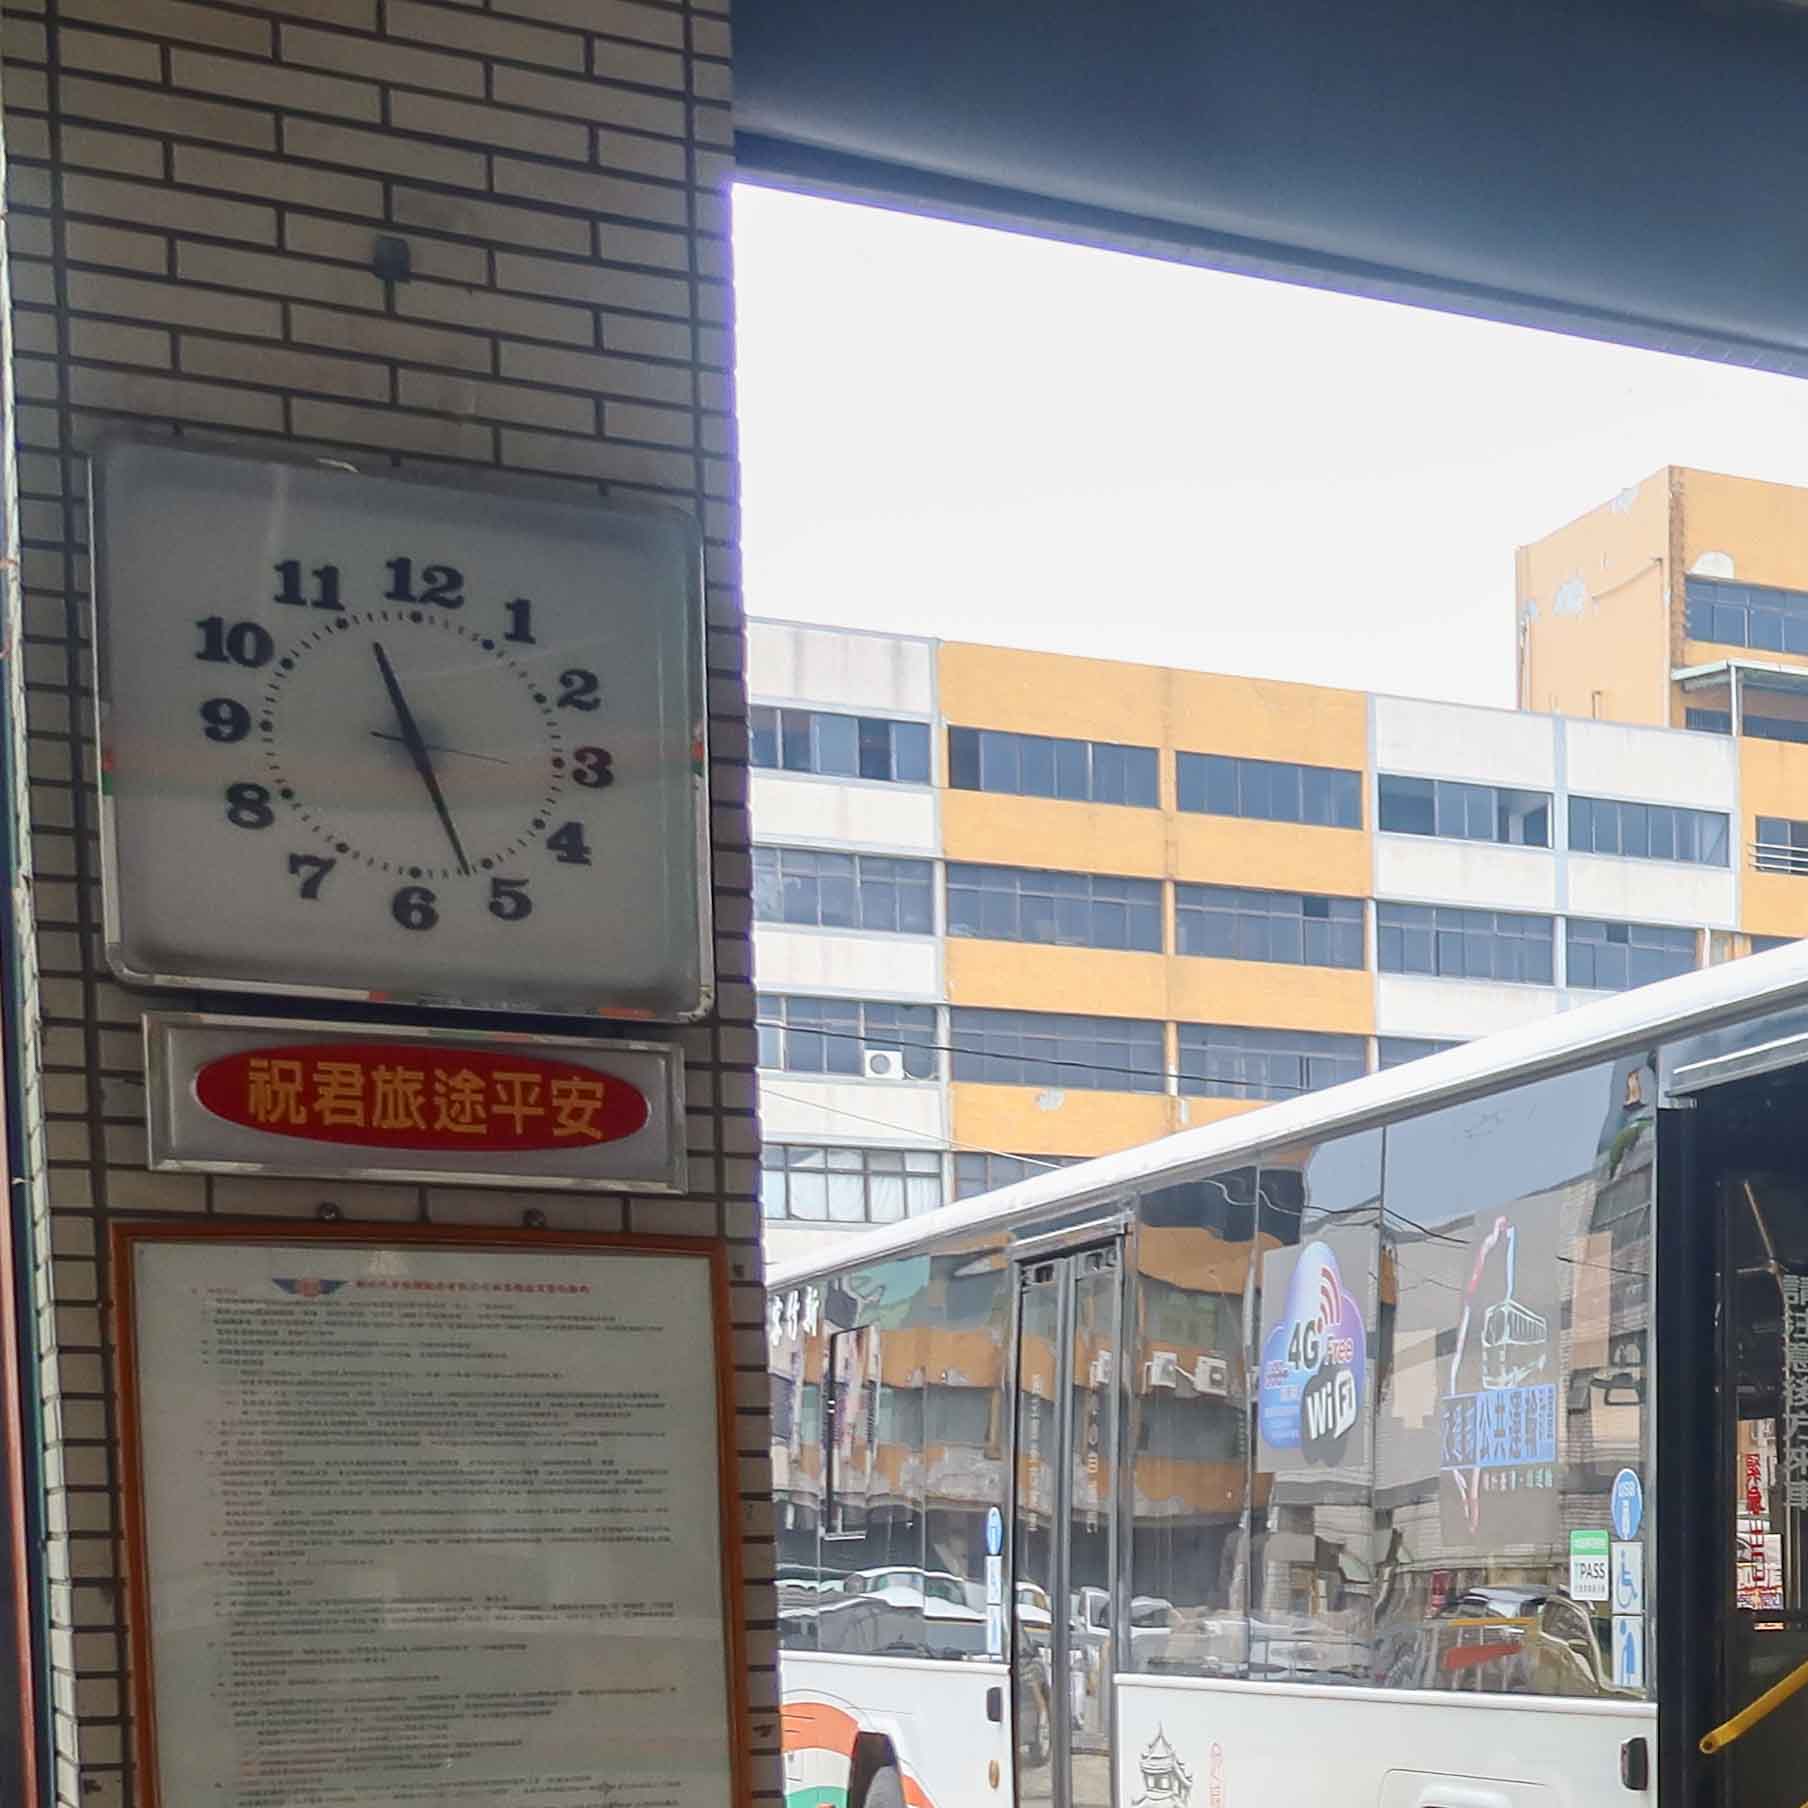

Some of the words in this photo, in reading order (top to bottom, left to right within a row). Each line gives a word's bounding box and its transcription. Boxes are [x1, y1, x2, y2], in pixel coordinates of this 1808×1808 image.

[273, 559, 344, 611] 11
[385, 558, 464, 610] 12
[195, 616, 274, 669] 10
[504, 599, 537, 644] 1
[557, 669, 600, 712] 2
[201, 697, 251, 743] 9
[572, 746, 615, 790] 3
[225, 782, 275, 831] 8
[547, 820, 593, 867] 4
[288, 853, 336, 901] 7
[488, 878, 533, 922] 5
[391, 886, 439, 931] 6
[248, 1056, 606, 1141] 祝君旅途平安
[1288, 1319, 1320, 1372] 4G
